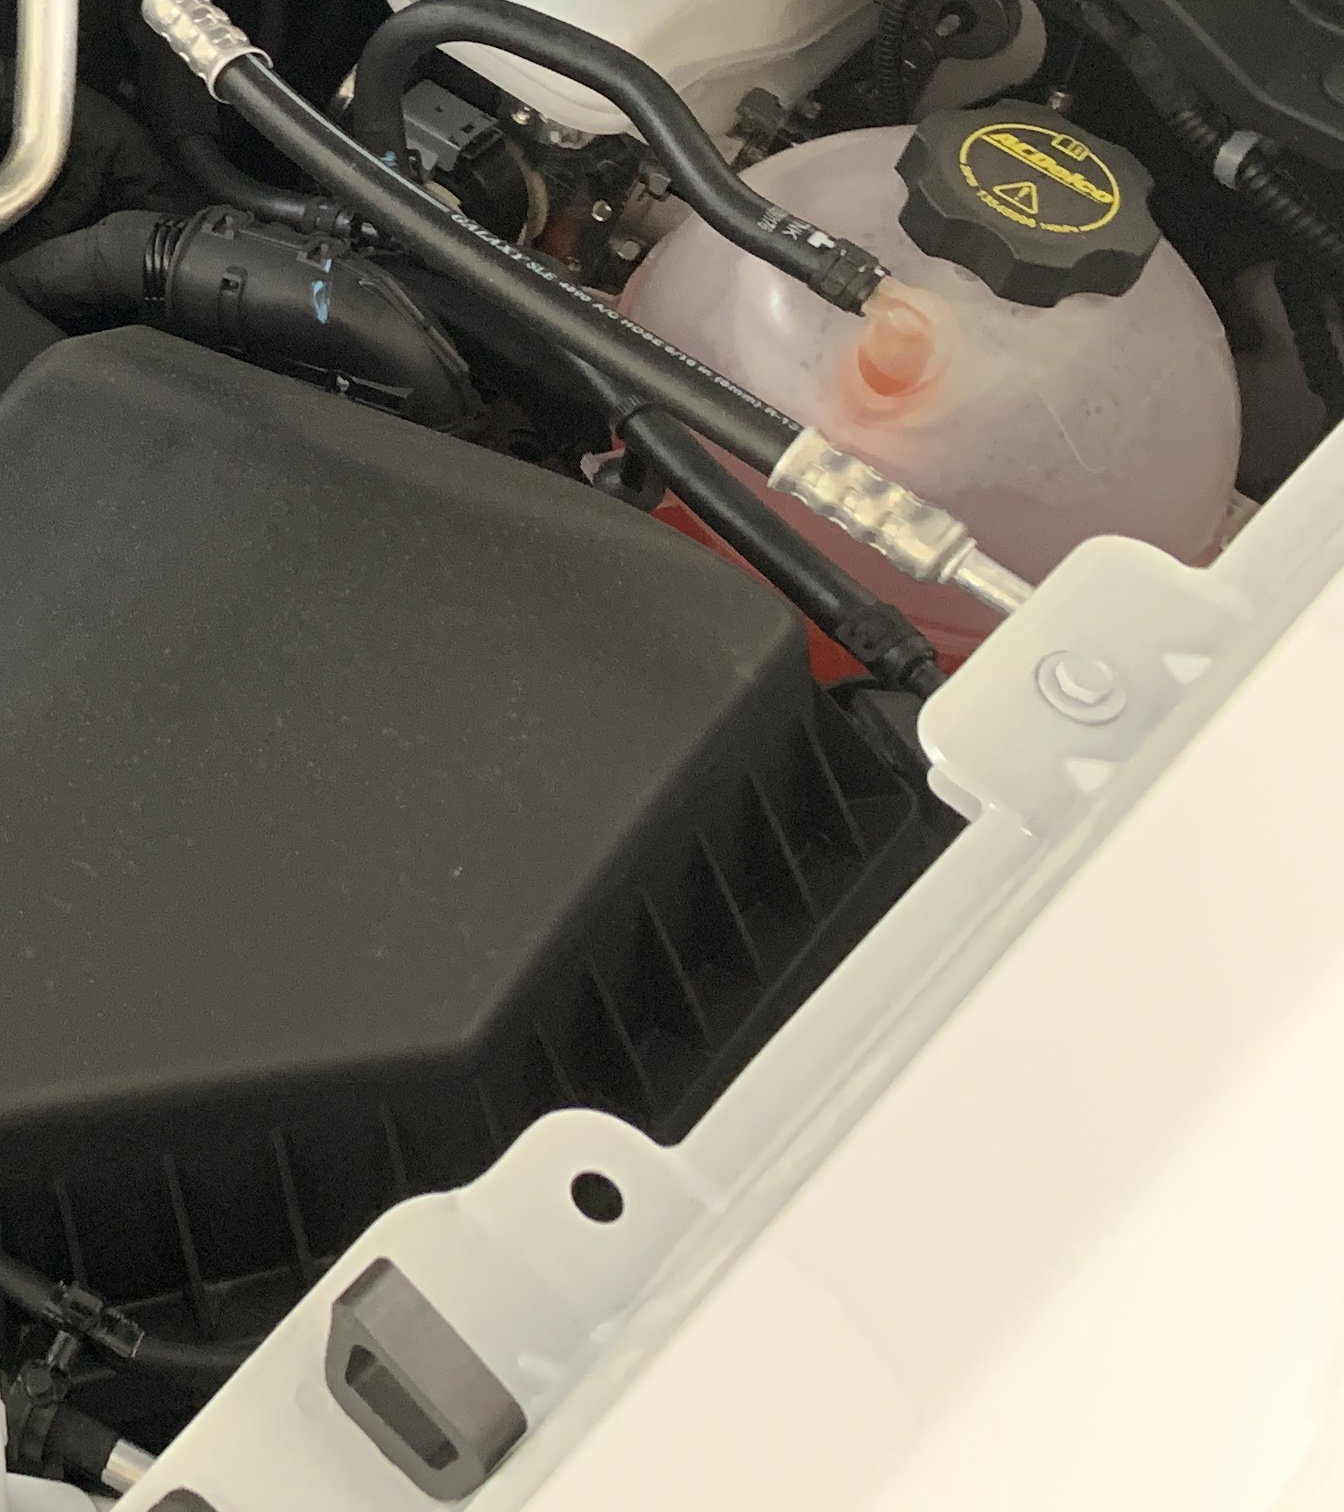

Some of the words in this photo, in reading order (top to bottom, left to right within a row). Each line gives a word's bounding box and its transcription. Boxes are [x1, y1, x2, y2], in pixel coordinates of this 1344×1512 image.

[989, 133, 1114, 203] ACDelco
[450, 213, 530, 261] GALAXY
[526, 261, 557, 281] SLE
[621, 319, 663, 347] HOSE
